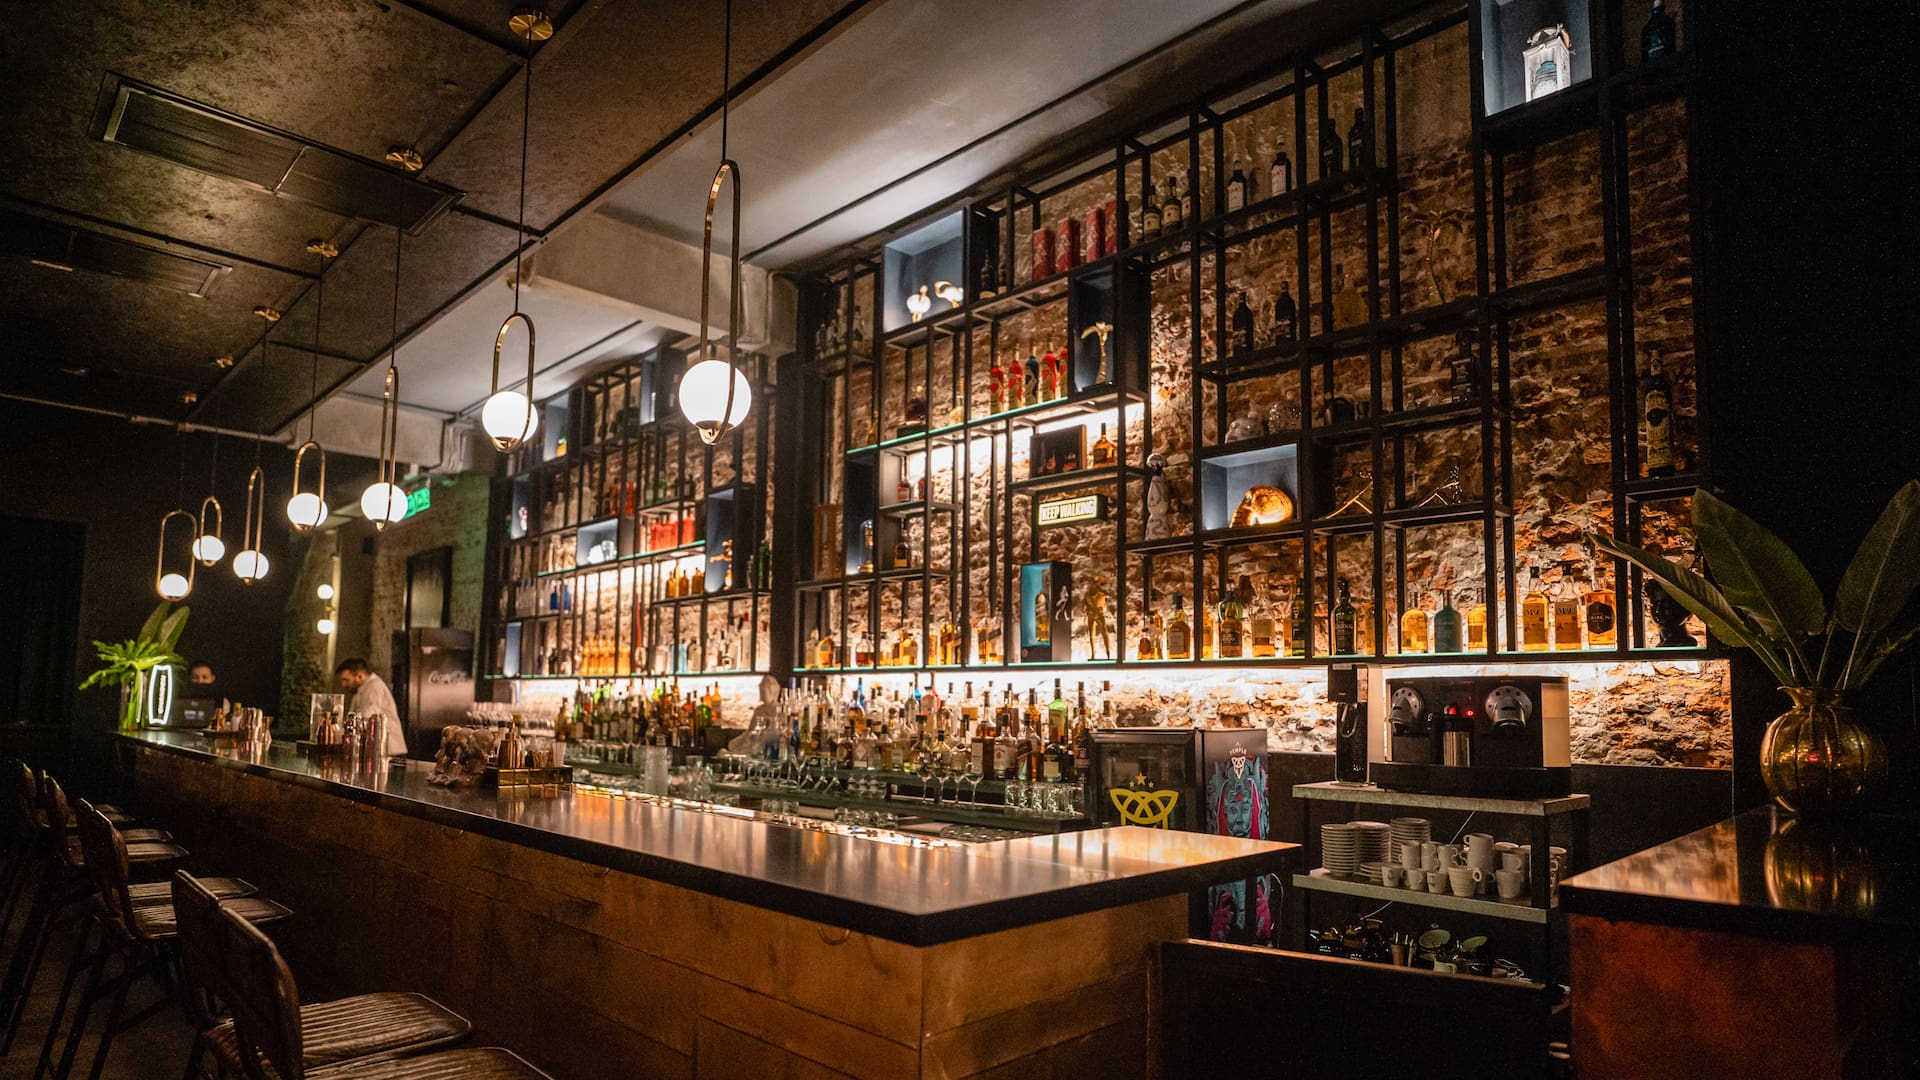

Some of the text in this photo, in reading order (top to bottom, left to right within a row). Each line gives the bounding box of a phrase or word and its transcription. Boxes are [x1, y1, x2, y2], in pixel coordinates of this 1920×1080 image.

[1041, 499, 1095, 522] KEEP WALKING
[1229, 747, 1247, 756] TEMPLE
